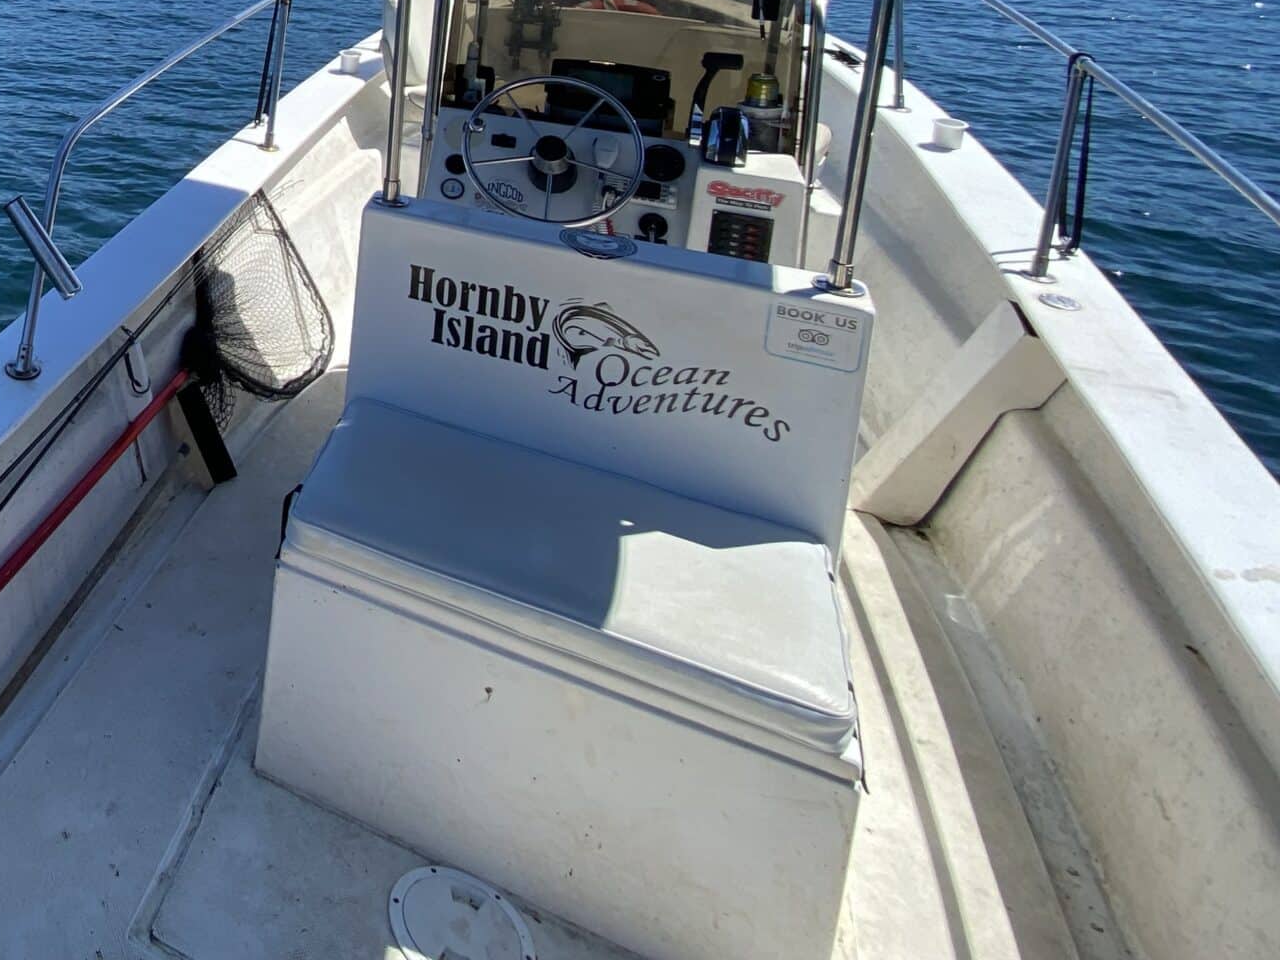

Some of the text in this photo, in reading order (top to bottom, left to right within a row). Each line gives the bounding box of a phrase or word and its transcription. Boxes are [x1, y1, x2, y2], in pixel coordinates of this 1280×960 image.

[408, 264, 550, 332] Hornby
[776, 305, 858, 331] BOOK US
[431, 307, 551, 370] Island
[595, 354, 731, 387] Ocean
[548, 375, 790, 442] Adventures
